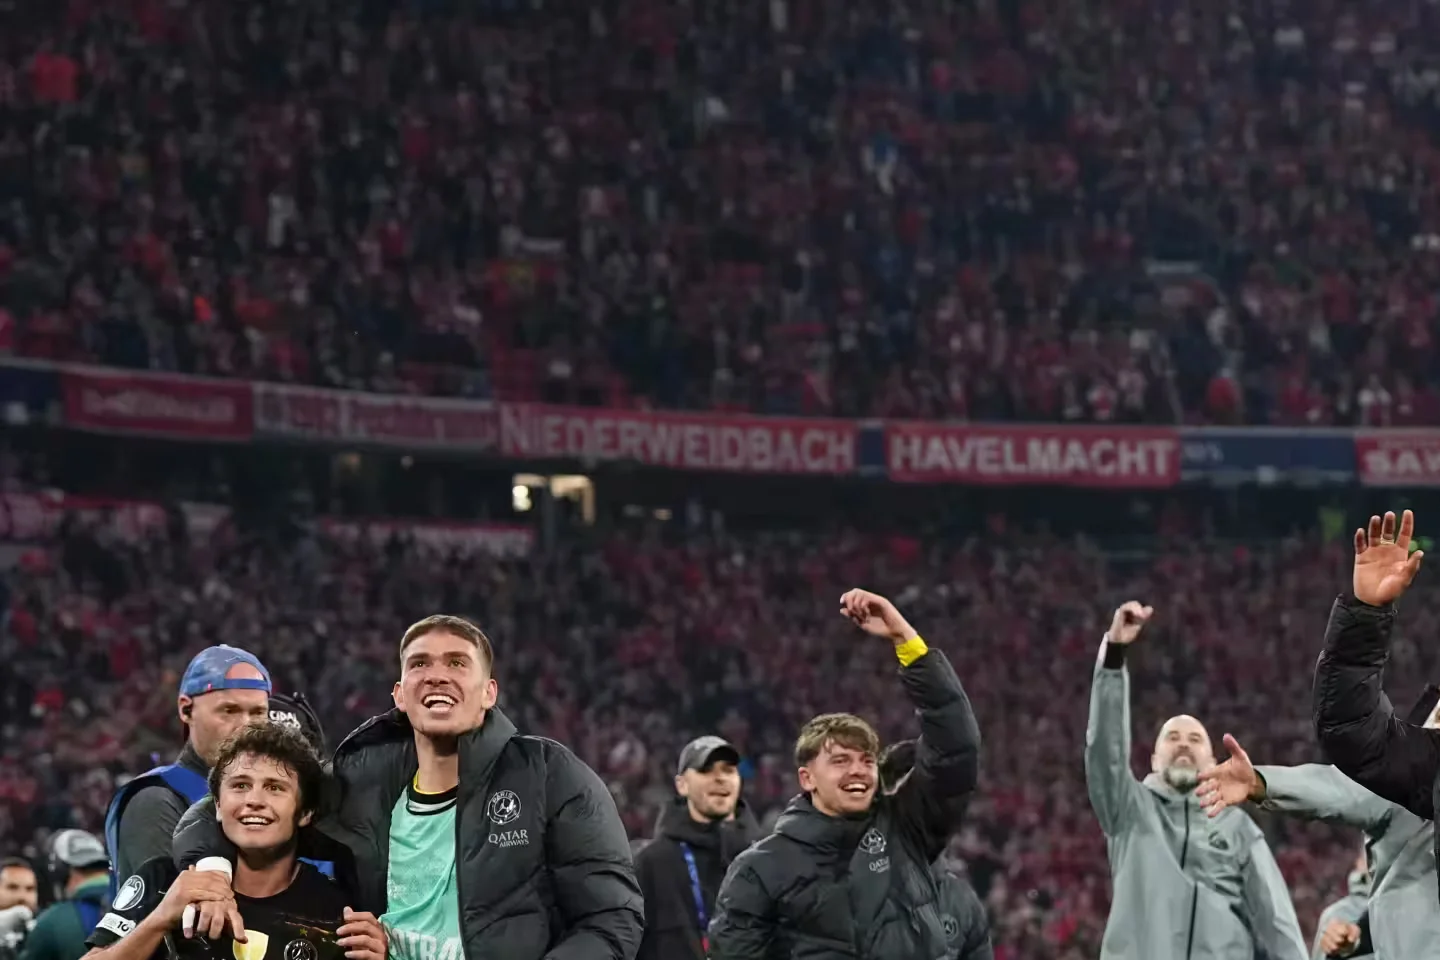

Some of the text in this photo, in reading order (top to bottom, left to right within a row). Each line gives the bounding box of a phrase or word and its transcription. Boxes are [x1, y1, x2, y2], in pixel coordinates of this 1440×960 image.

[499, 403, 854, 471] NIEDERWEIDBACH
[890, 434, 1174, 476] HAVELMACHT
[488, 829, 529, 845] QATAR
[499, 839, 530, 848] AIRWAYS
